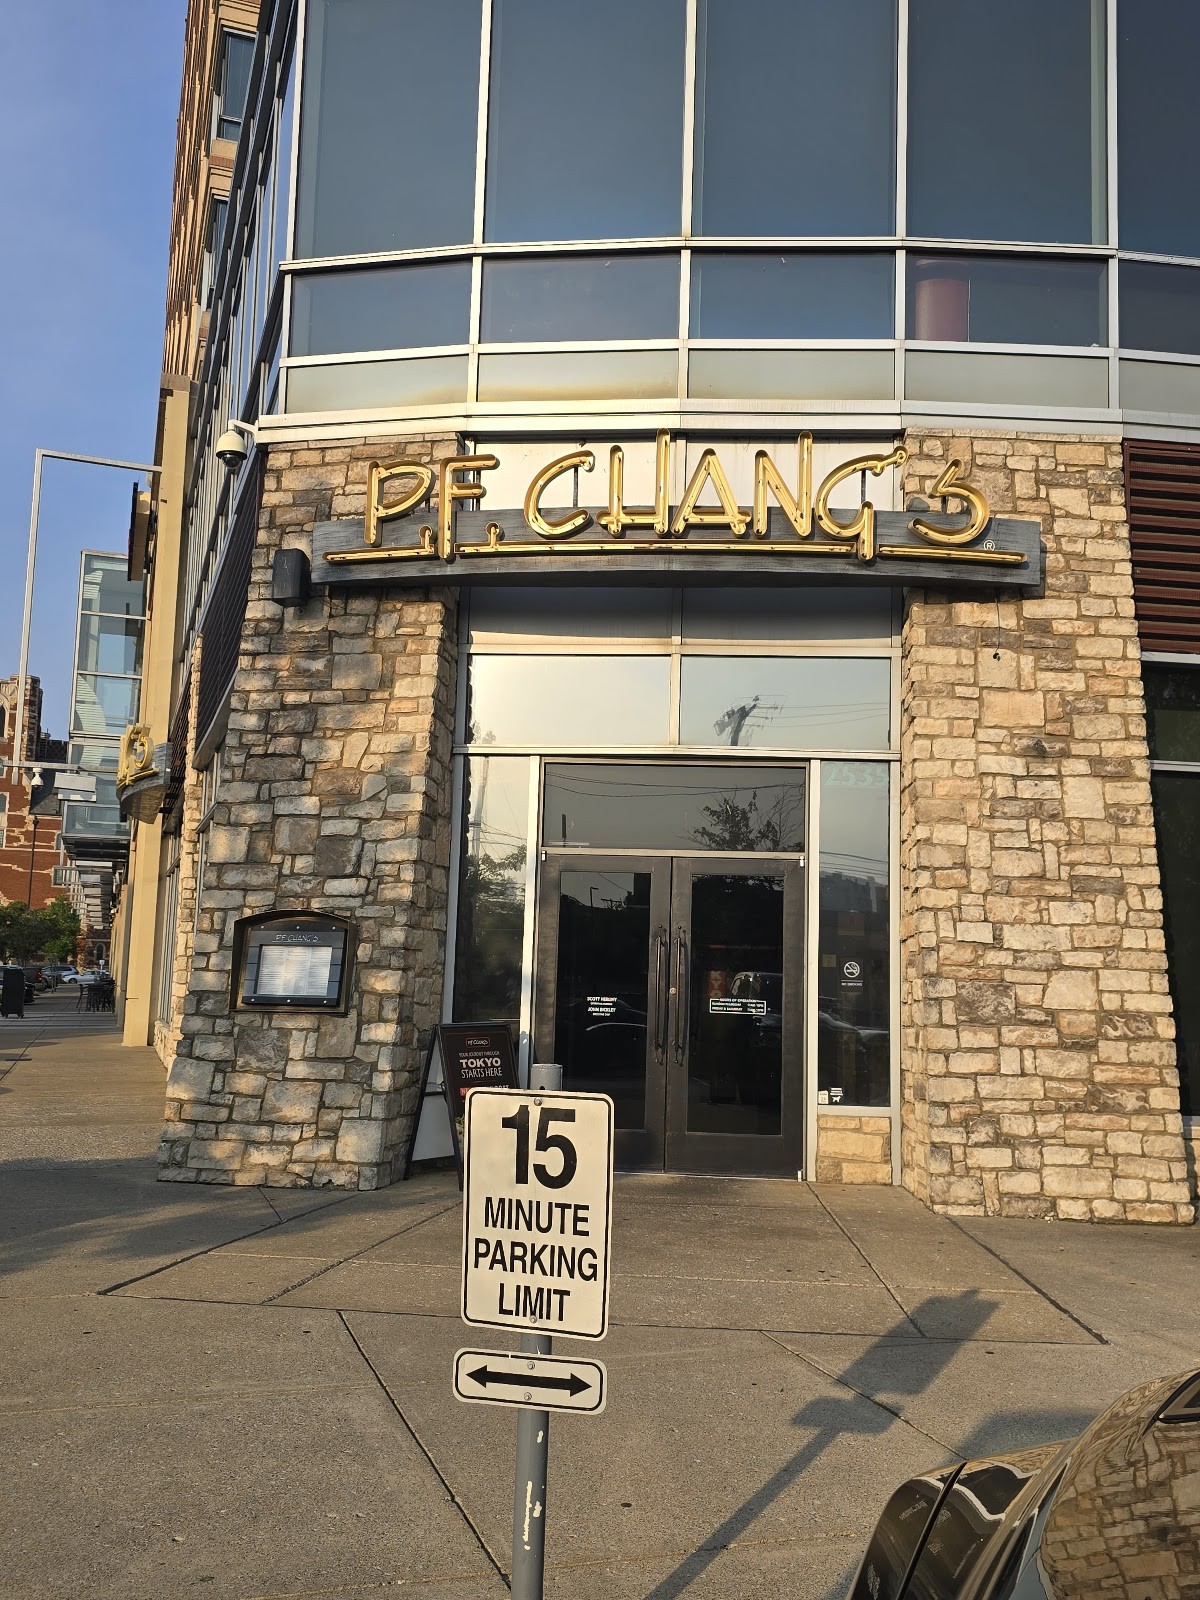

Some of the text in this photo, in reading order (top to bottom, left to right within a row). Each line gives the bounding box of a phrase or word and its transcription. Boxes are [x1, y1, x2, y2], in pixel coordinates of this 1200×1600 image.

[459, 1057, 501, 1069] TOKYO
[461, 1067, 503, 1079] STARTS HERE
[501, 1104, 578, 1190] 15
[484, 1196, 590, 1237] MINUTE
[473, 1237, 599, 1282] PARKING
[498, 1282, 571, 1322] LIMIT
